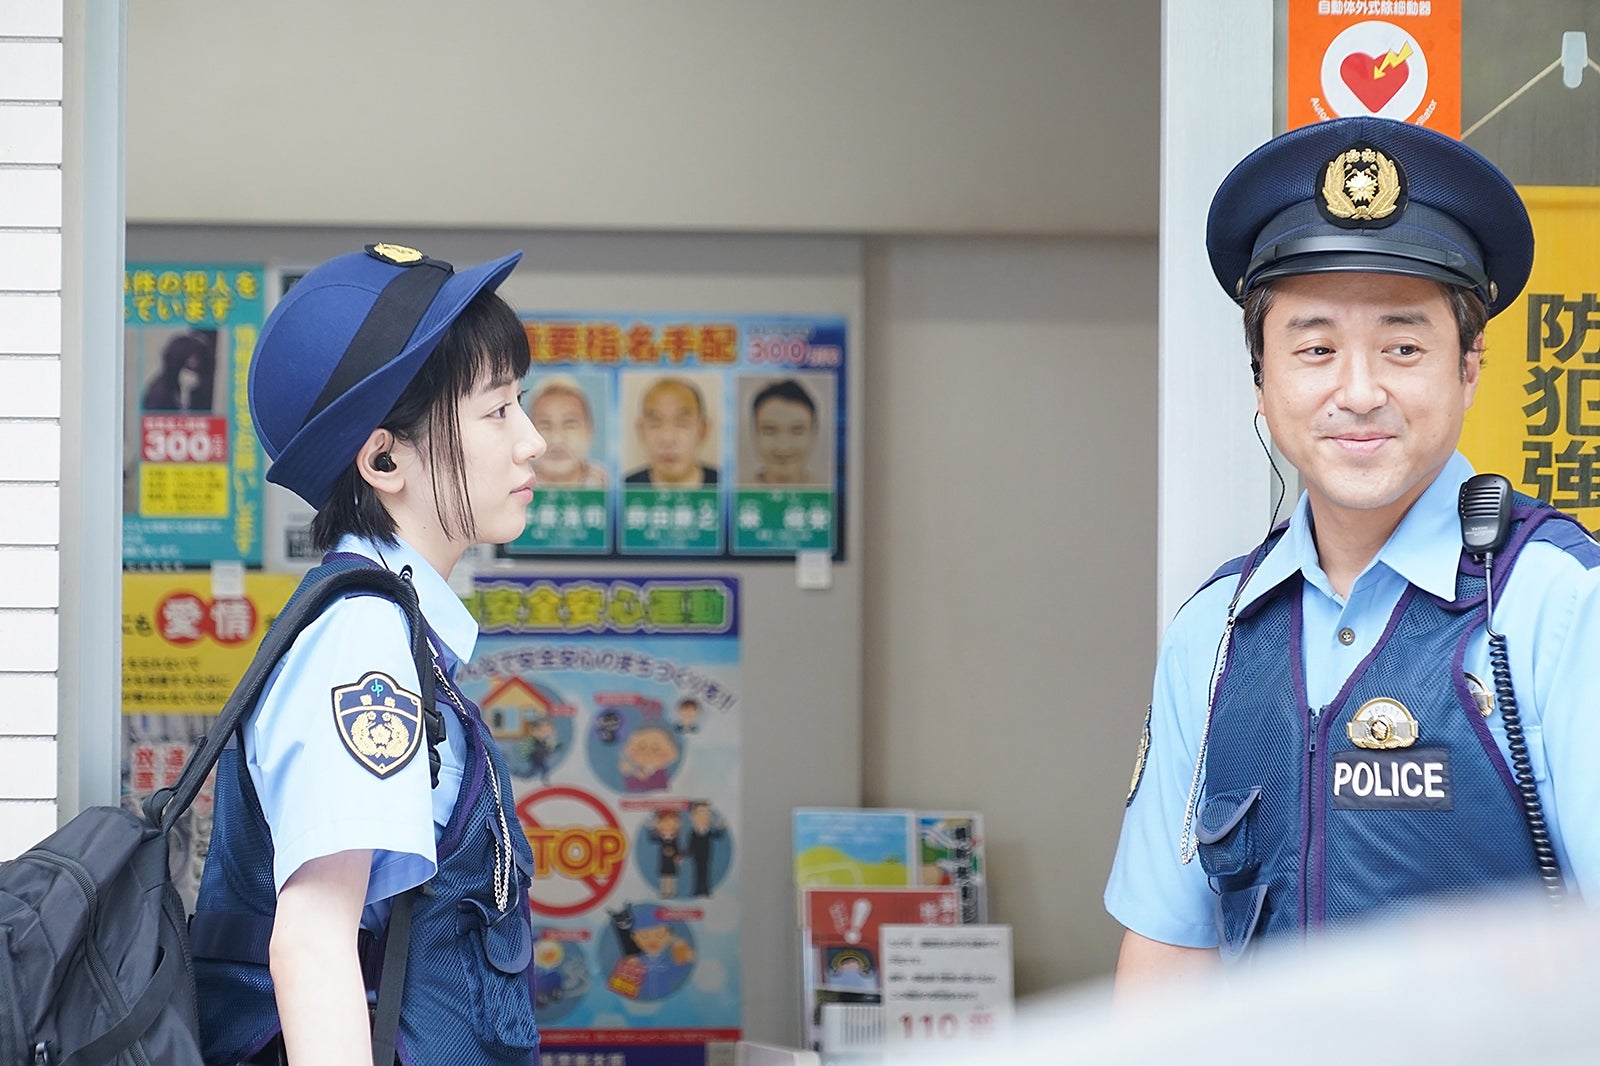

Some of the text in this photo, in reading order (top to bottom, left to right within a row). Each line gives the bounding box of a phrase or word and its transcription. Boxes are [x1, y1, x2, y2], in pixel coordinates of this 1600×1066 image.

[1318, 0, 1431, 16] 自動体外式除細動器
[124, 269, 257, 299] 件の犯人を
[124, 294, 231, 324] ています
[1522, 293, 1600, 520] 防犯強
[464, 586, 726, 627] 安全安心運動
[1333, 761, 1445, 798] POLICE
[524, 826, 626, 880] TOP
